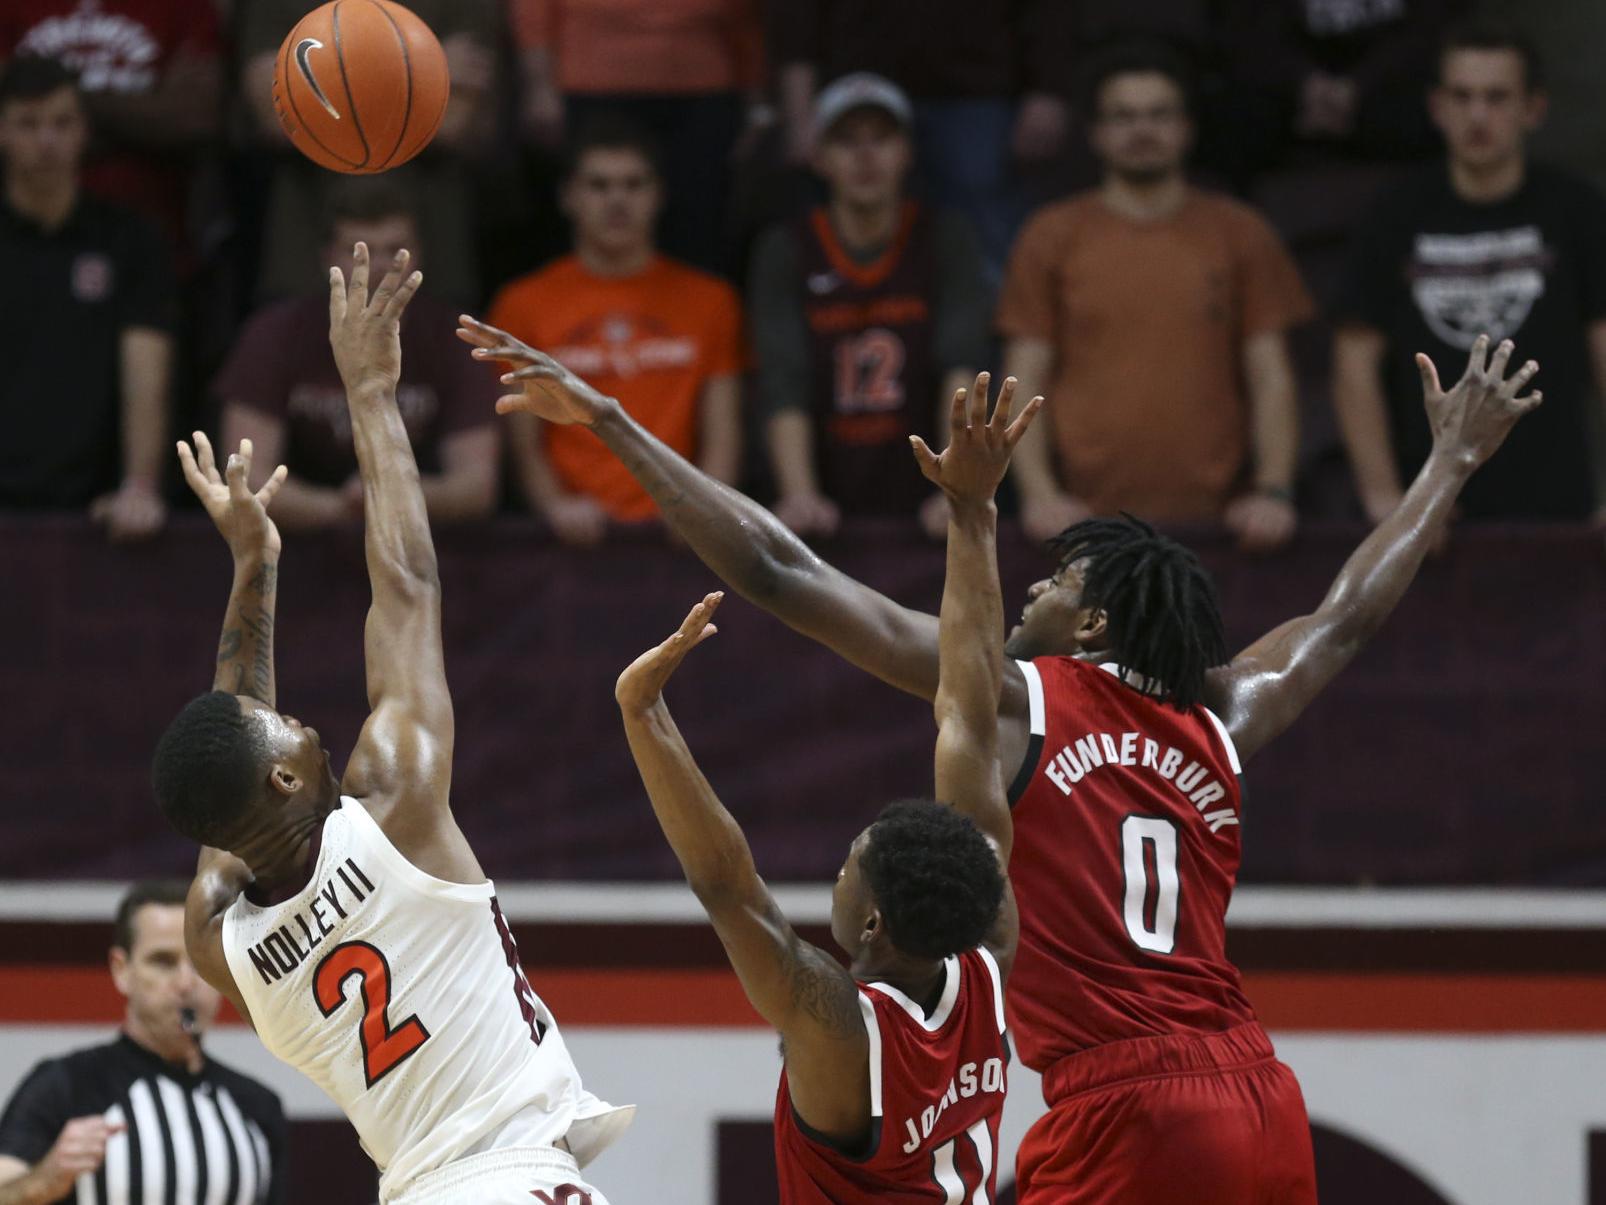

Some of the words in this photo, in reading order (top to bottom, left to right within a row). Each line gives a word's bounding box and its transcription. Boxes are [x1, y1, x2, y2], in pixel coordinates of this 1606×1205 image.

[834, 329, 906, 413] 12
[1044, 731, 1240, 834] FUNDERBURK
[247, 879, 348, 986] NOLLEY
[336, 857, 376, 903] II
[1120, 812, 1182, 956] 0
[312, 939, 431, 1090] 2
[903, 1057, 1005, 1154] JONSO
